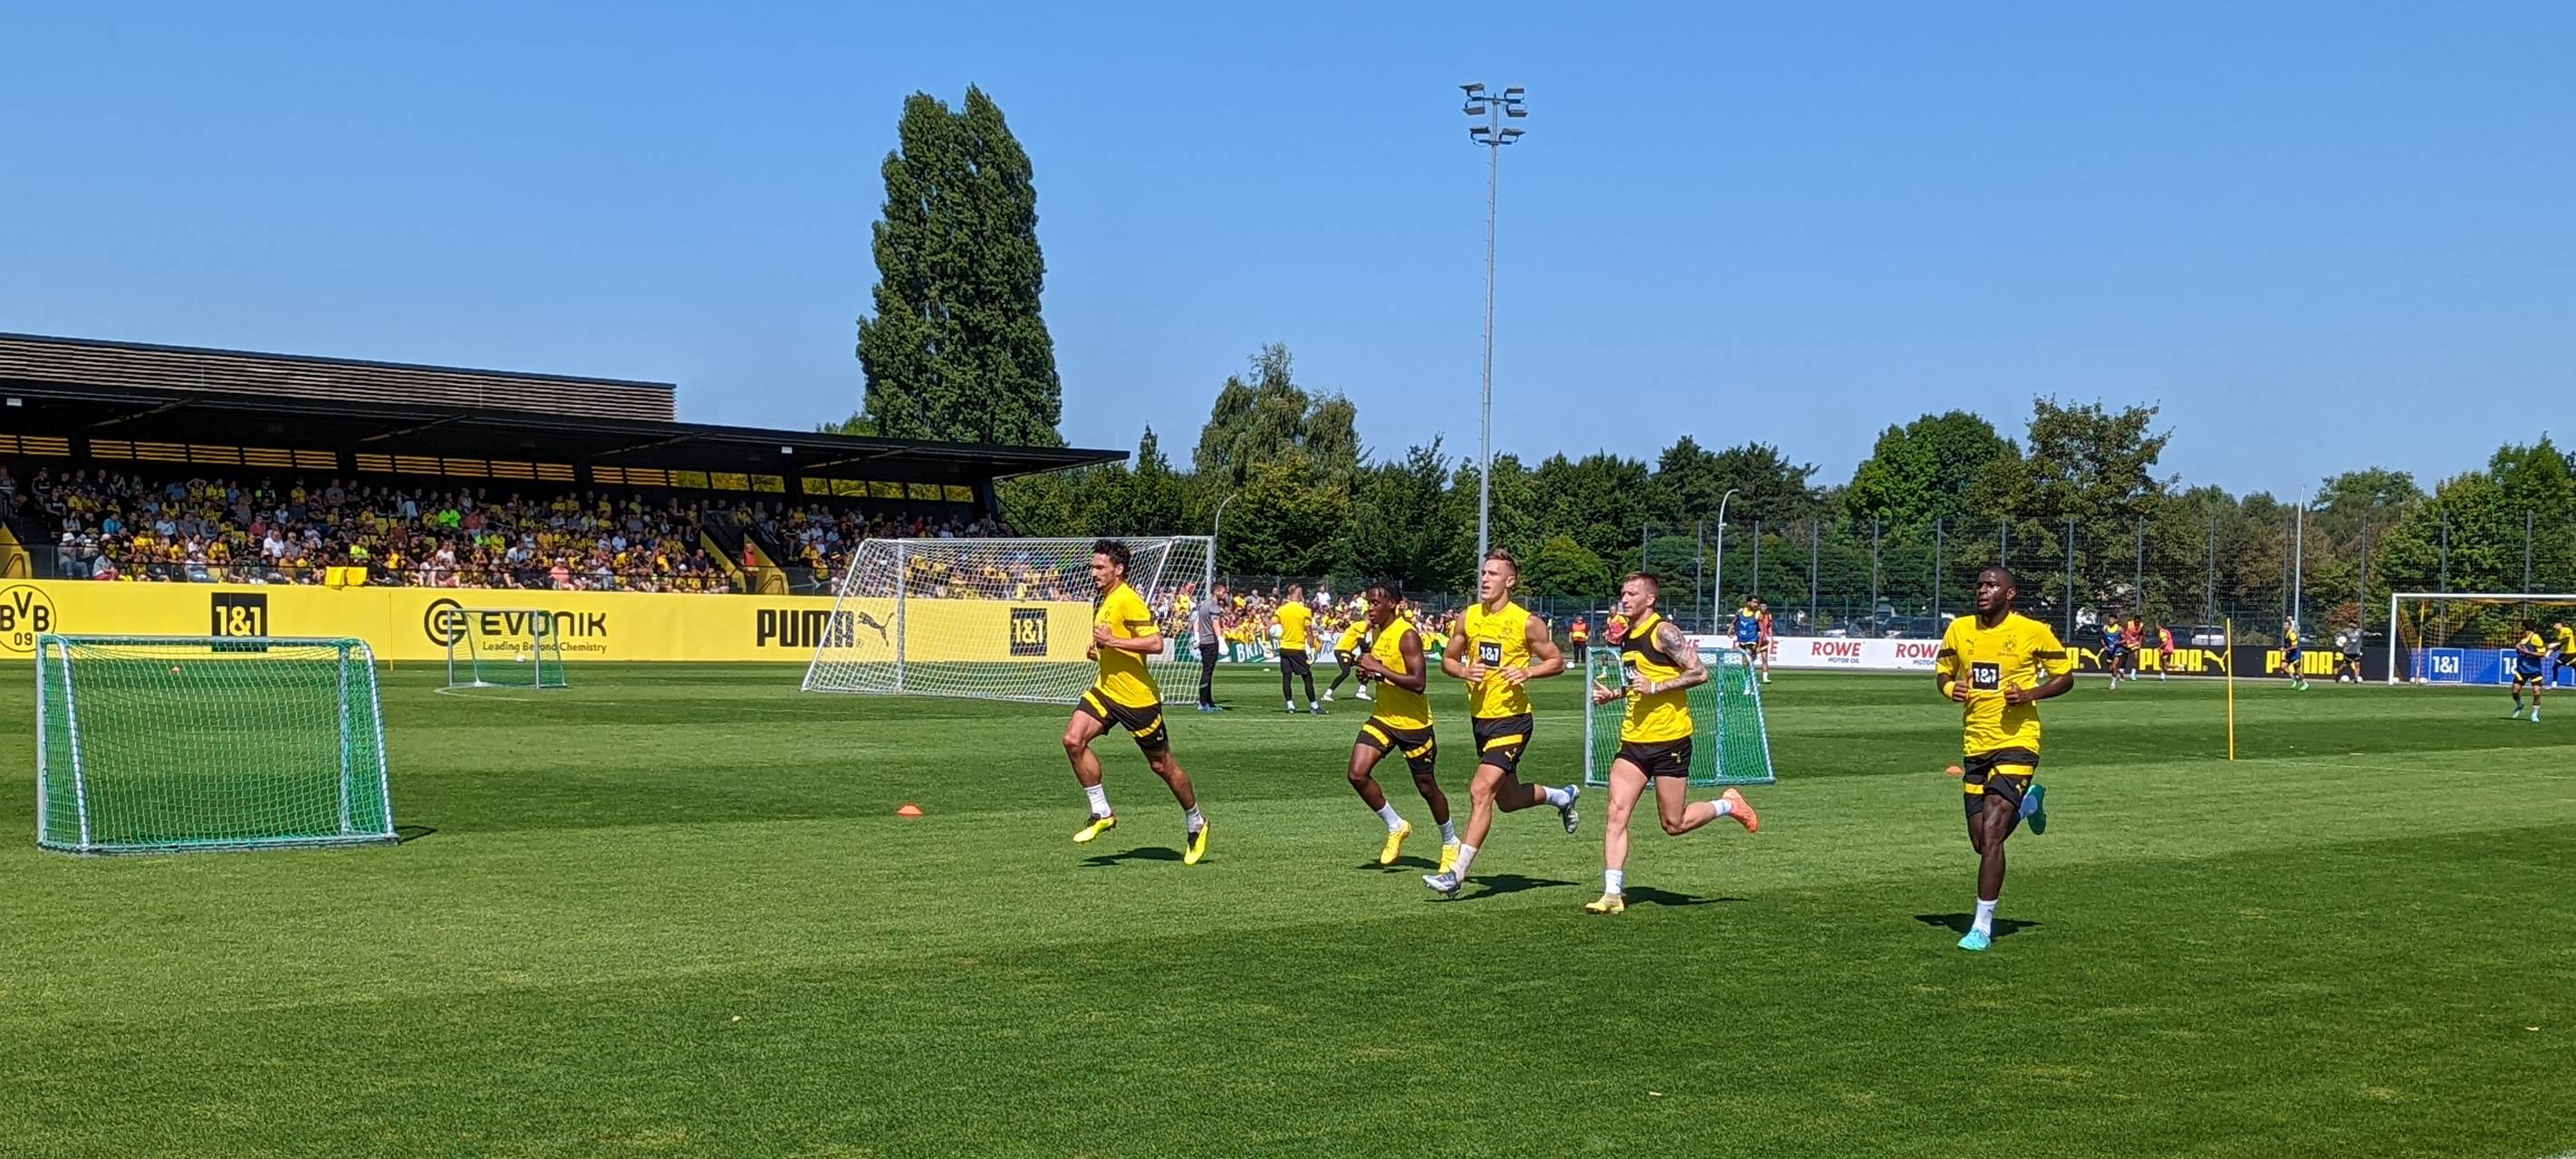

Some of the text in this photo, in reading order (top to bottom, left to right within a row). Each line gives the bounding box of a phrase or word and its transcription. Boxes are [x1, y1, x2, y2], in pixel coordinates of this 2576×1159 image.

[0, 591, 49, 631] BVB
[216, 606, 261, 636] 1&1
[481, 610, 607, 637] EVONIK
[756, 609, 854, 647] PUMA
[14, 632, 33, 646] 09
[1014, 619, 1043, 643] 1&1
[483, 641, 607, 653] Leading Beond Chemistry
[1481, 647, 1499, 661] 1&1
[1812, 641, 1861, 656] ROWE
[1896, 644, 1938, 657] ROW
[2433, 656, 2459, 674] 1&1
[1974, 668, 1996, 683] 1&1
